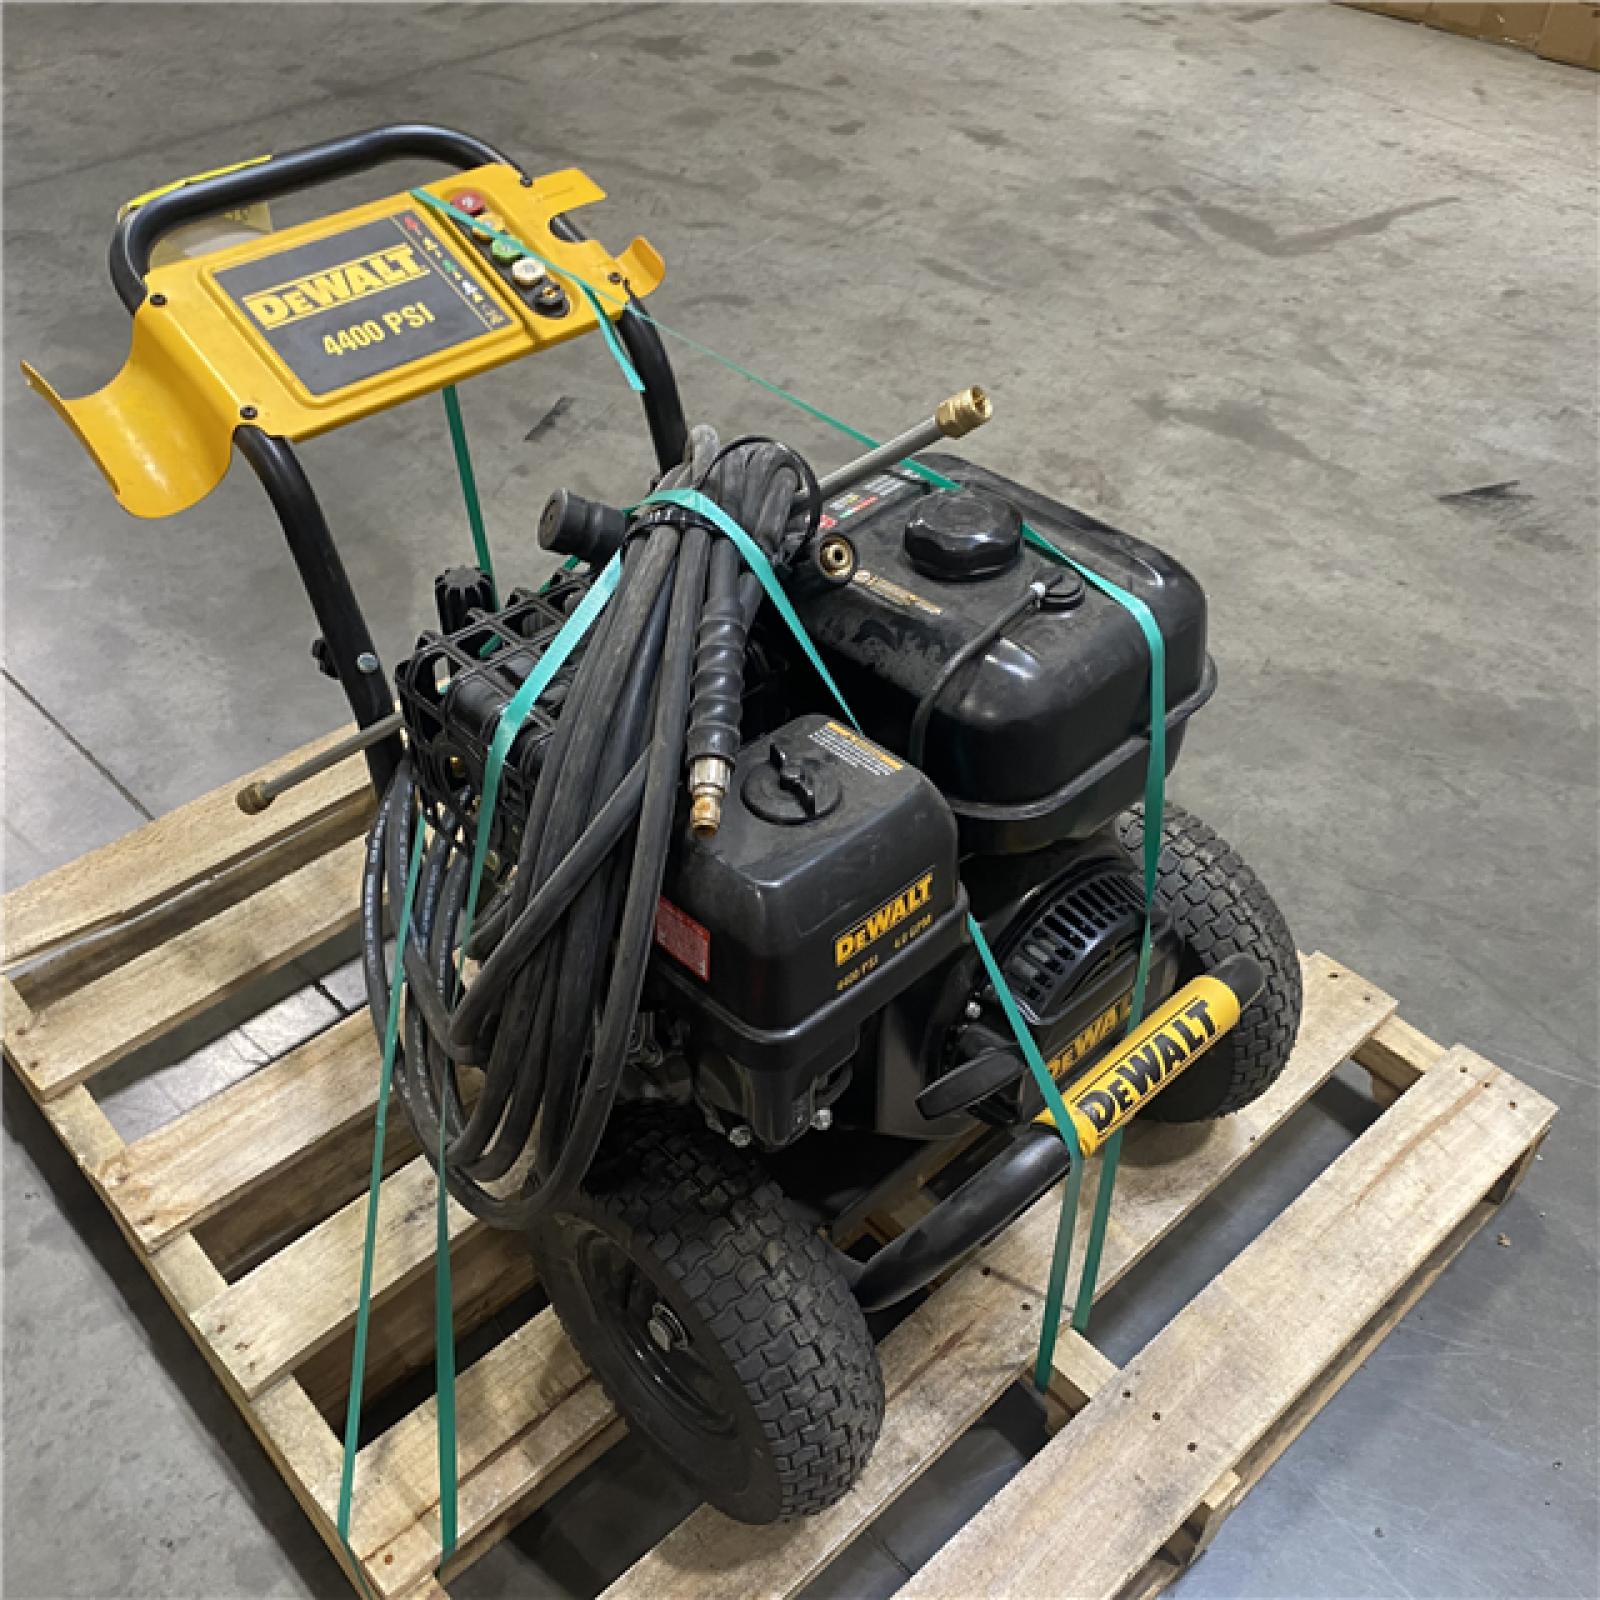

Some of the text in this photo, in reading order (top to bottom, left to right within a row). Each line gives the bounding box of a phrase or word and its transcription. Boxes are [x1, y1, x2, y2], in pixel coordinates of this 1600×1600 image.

[245, 246, 426, 328] DEWALT
[322, 301, 436, 356] 4400 PSI
[834, 871, 934, 967] DEWALT
[1077, 999, 1216, 1132] DEWALT
